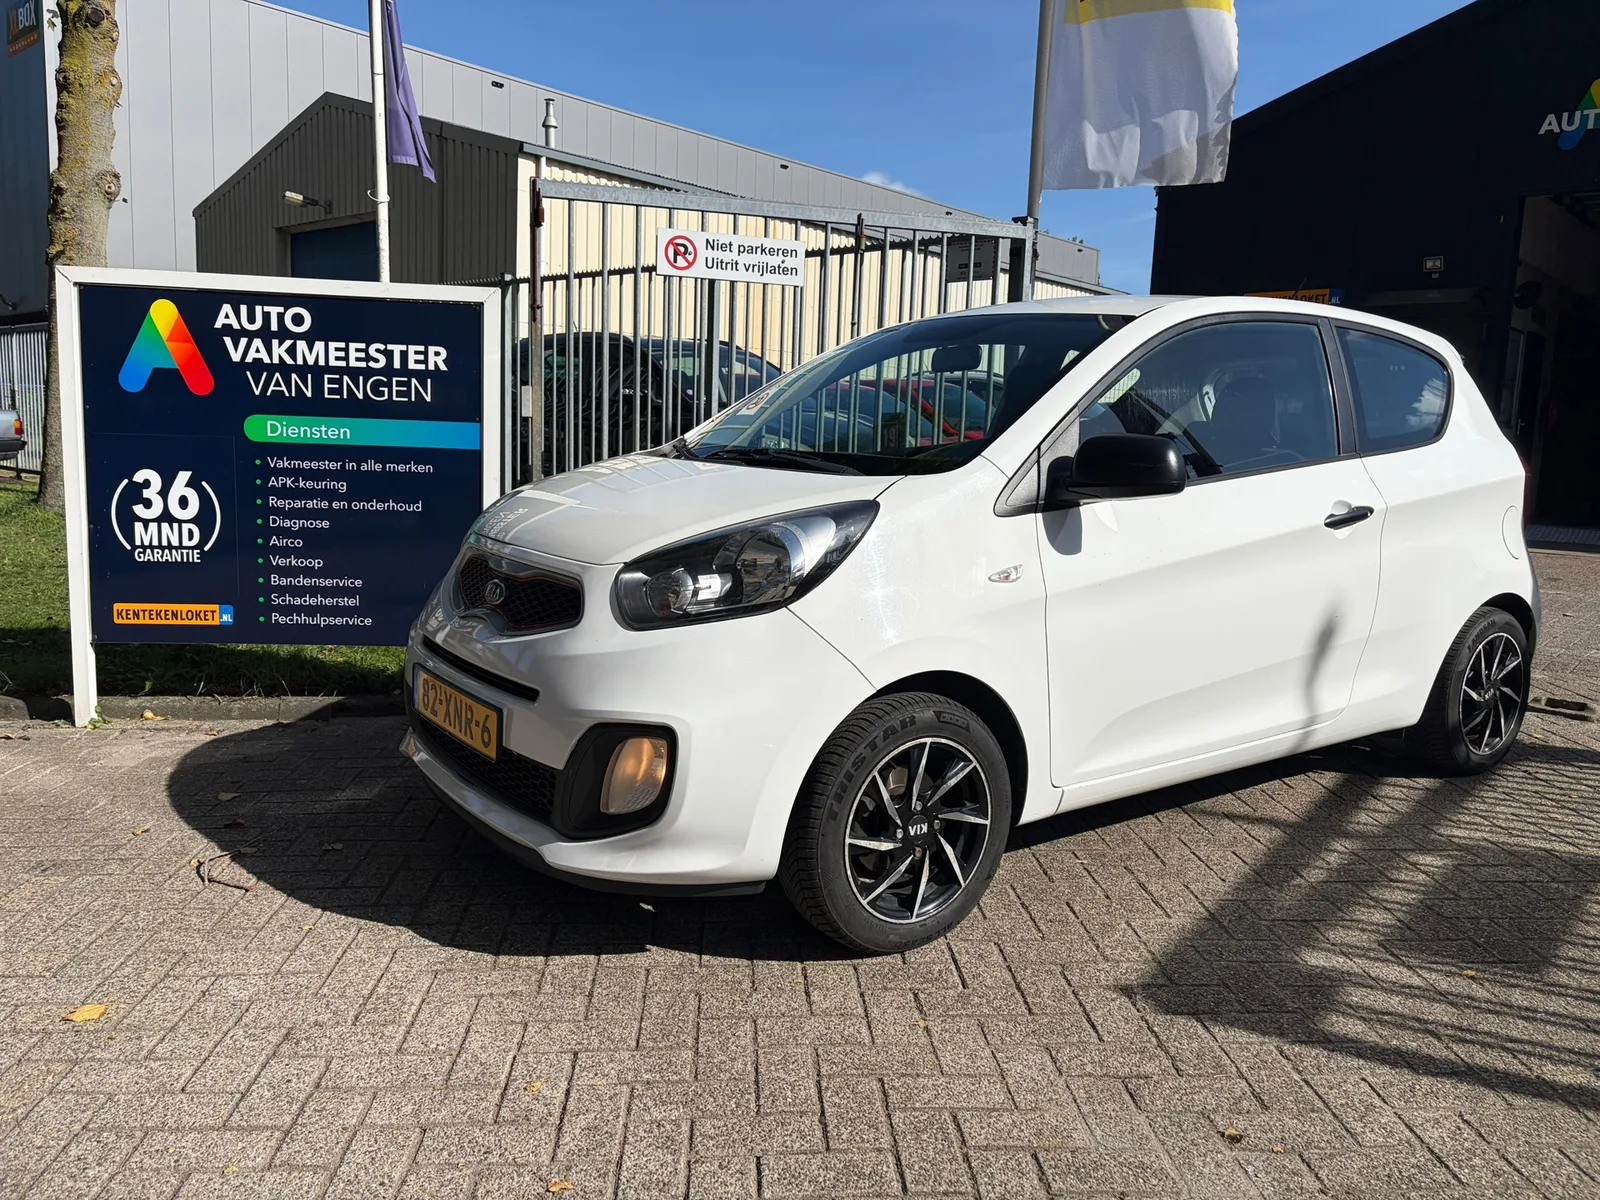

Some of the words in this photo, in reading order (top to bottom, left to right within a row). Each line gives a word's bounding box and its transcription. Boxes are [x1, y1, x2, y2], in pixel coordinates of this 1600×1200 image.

[1537, 108, 1600, 135] AUT
[705, 238, 734, 253] Niet
[737, 243, 798, 258] parkeren
[705, 257, 739, 271] Uitrit
[743, 259, 798, 277] vrijlaten
[213, 303, 312, 334] AUTO
[222, 336, 449, 373] VAKMEESTER
[245, 370, 312, 398] VAN
[323, 374, 432, 403] ENGEN
[266, 420, 351, 440] Diensten
[267, 456, 343, 471] Vakmeester
[345, 459, 357, 471] in
[360, 459, 383, 472] alle
[386, 461, 434, 473] merken
[268, 476, 347, 492] APK-keuring
[131, 468, 200, 521] 36
[268, 495, 329, 511] Reparatie
[332, 501, 348, 510] en
[351, 498, 422, 512] onderhoud
[269, 515, 330, 530] Diagnose
[134, 521, 201, 547] MND
[269, 535, 303, 548] Airco
[134, 548, 201, 563] GARANTIE
[269, 554, 324, 570] Verkoop
[270, 574, 363, 588] Bandenservice
[270, 593, 360, 607] Schadeherstel
[487, 583, 500, 600] KIA
[271, 612, 373, 628] Pechhulpservice
[422, 678, 492, 749] 82-XNR-6
[908, 822, 929, 837] KIA
